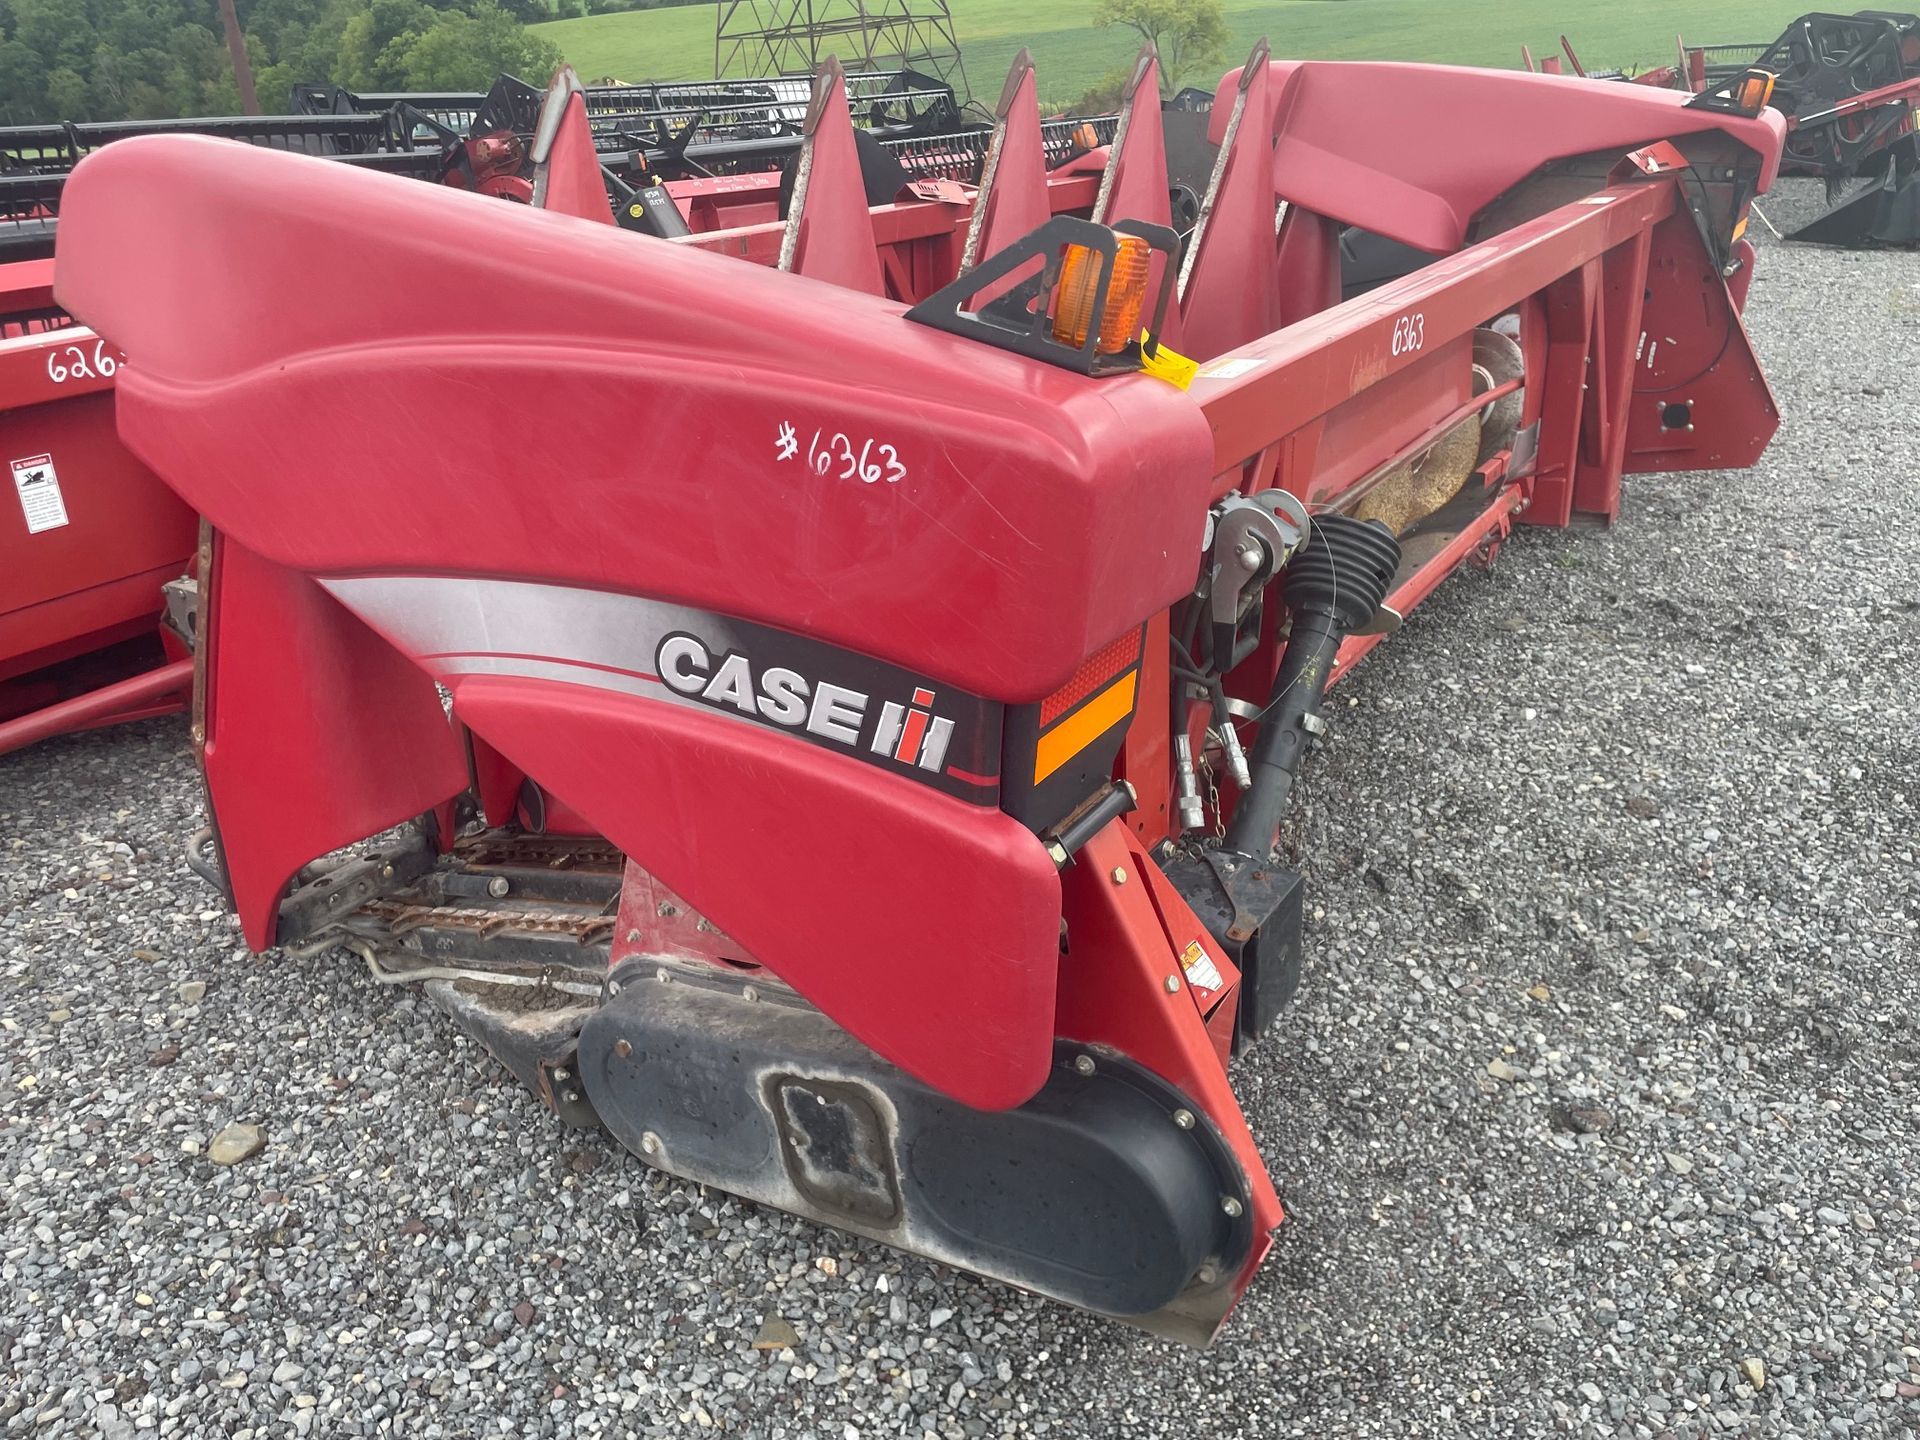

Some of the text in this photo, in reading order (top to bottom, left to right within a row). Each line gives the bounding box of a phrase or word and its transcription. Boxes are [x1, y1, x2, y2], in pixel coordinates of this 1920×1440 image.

[1392, 313, 1425, 356] 6363
[48, 339, 126, 382] 626
[658, 636, 869, 746] CASE
